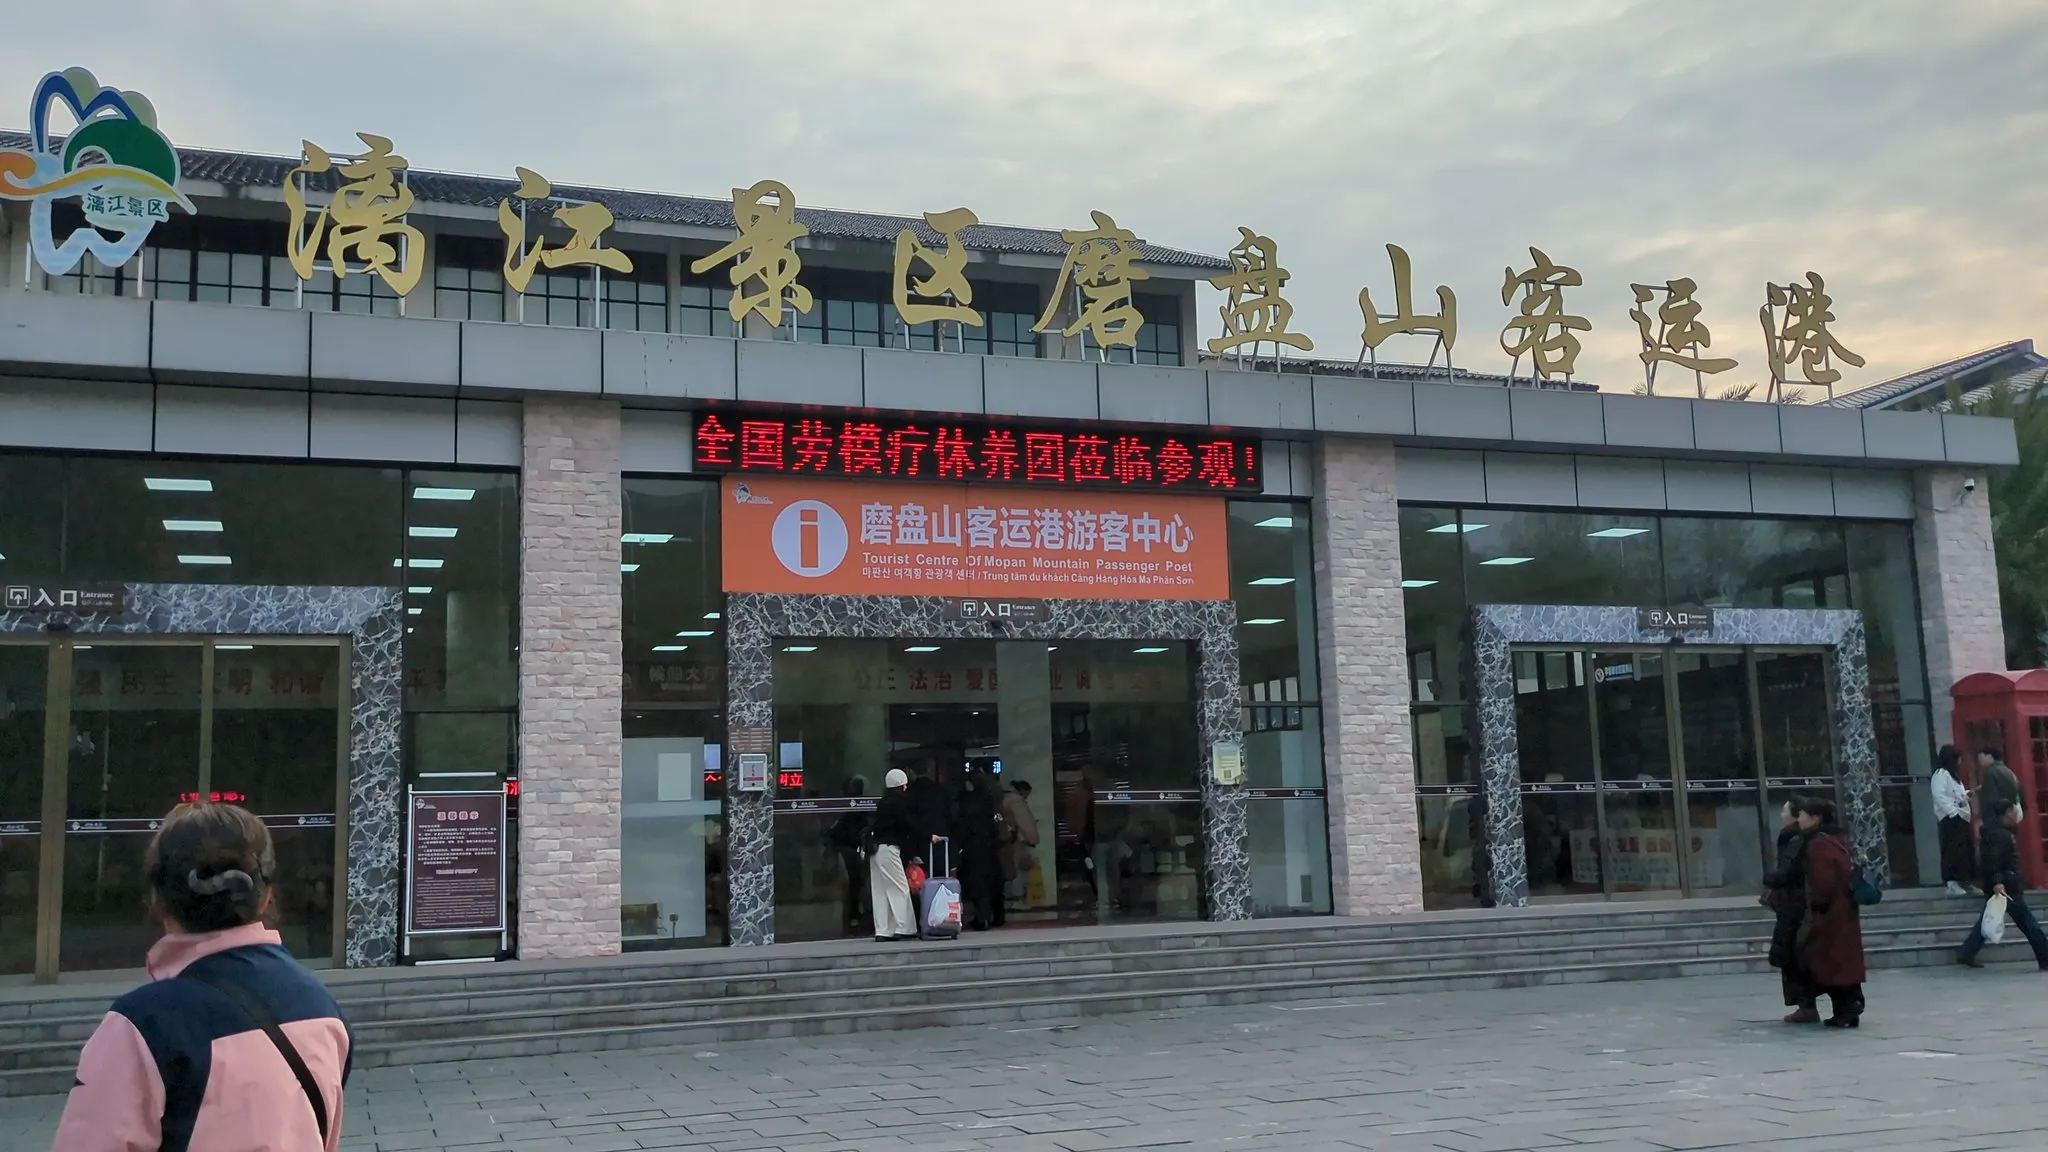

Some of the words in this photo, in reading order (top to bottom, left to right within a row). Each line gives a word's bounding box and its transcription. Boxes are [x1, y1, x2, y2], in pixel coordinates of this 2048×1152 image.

[86, 193, 165, 217] 漓江景区
[860, 503, 1194, 552] 磨盘山客运港游客中心
[863, 553, 910, 565] Tourist
[916, 554, 959, 566] Centre
[966, 555, 981, 566] Of
[985, 556, 1026, 569] Mopan
[1032, 557, 1090, 569] Mountain
[1096, 559, 1159, 573] Passenger
[1166, 561, 1193, 572] Poet
[983, 571, 1009, 582] Trung
[1030, 572, 1041, 581] du
[34, 588, 77, 606] 入口
[980, 602, 1011, 617] 入口
[1664, 612, 1688, 625] 入口
